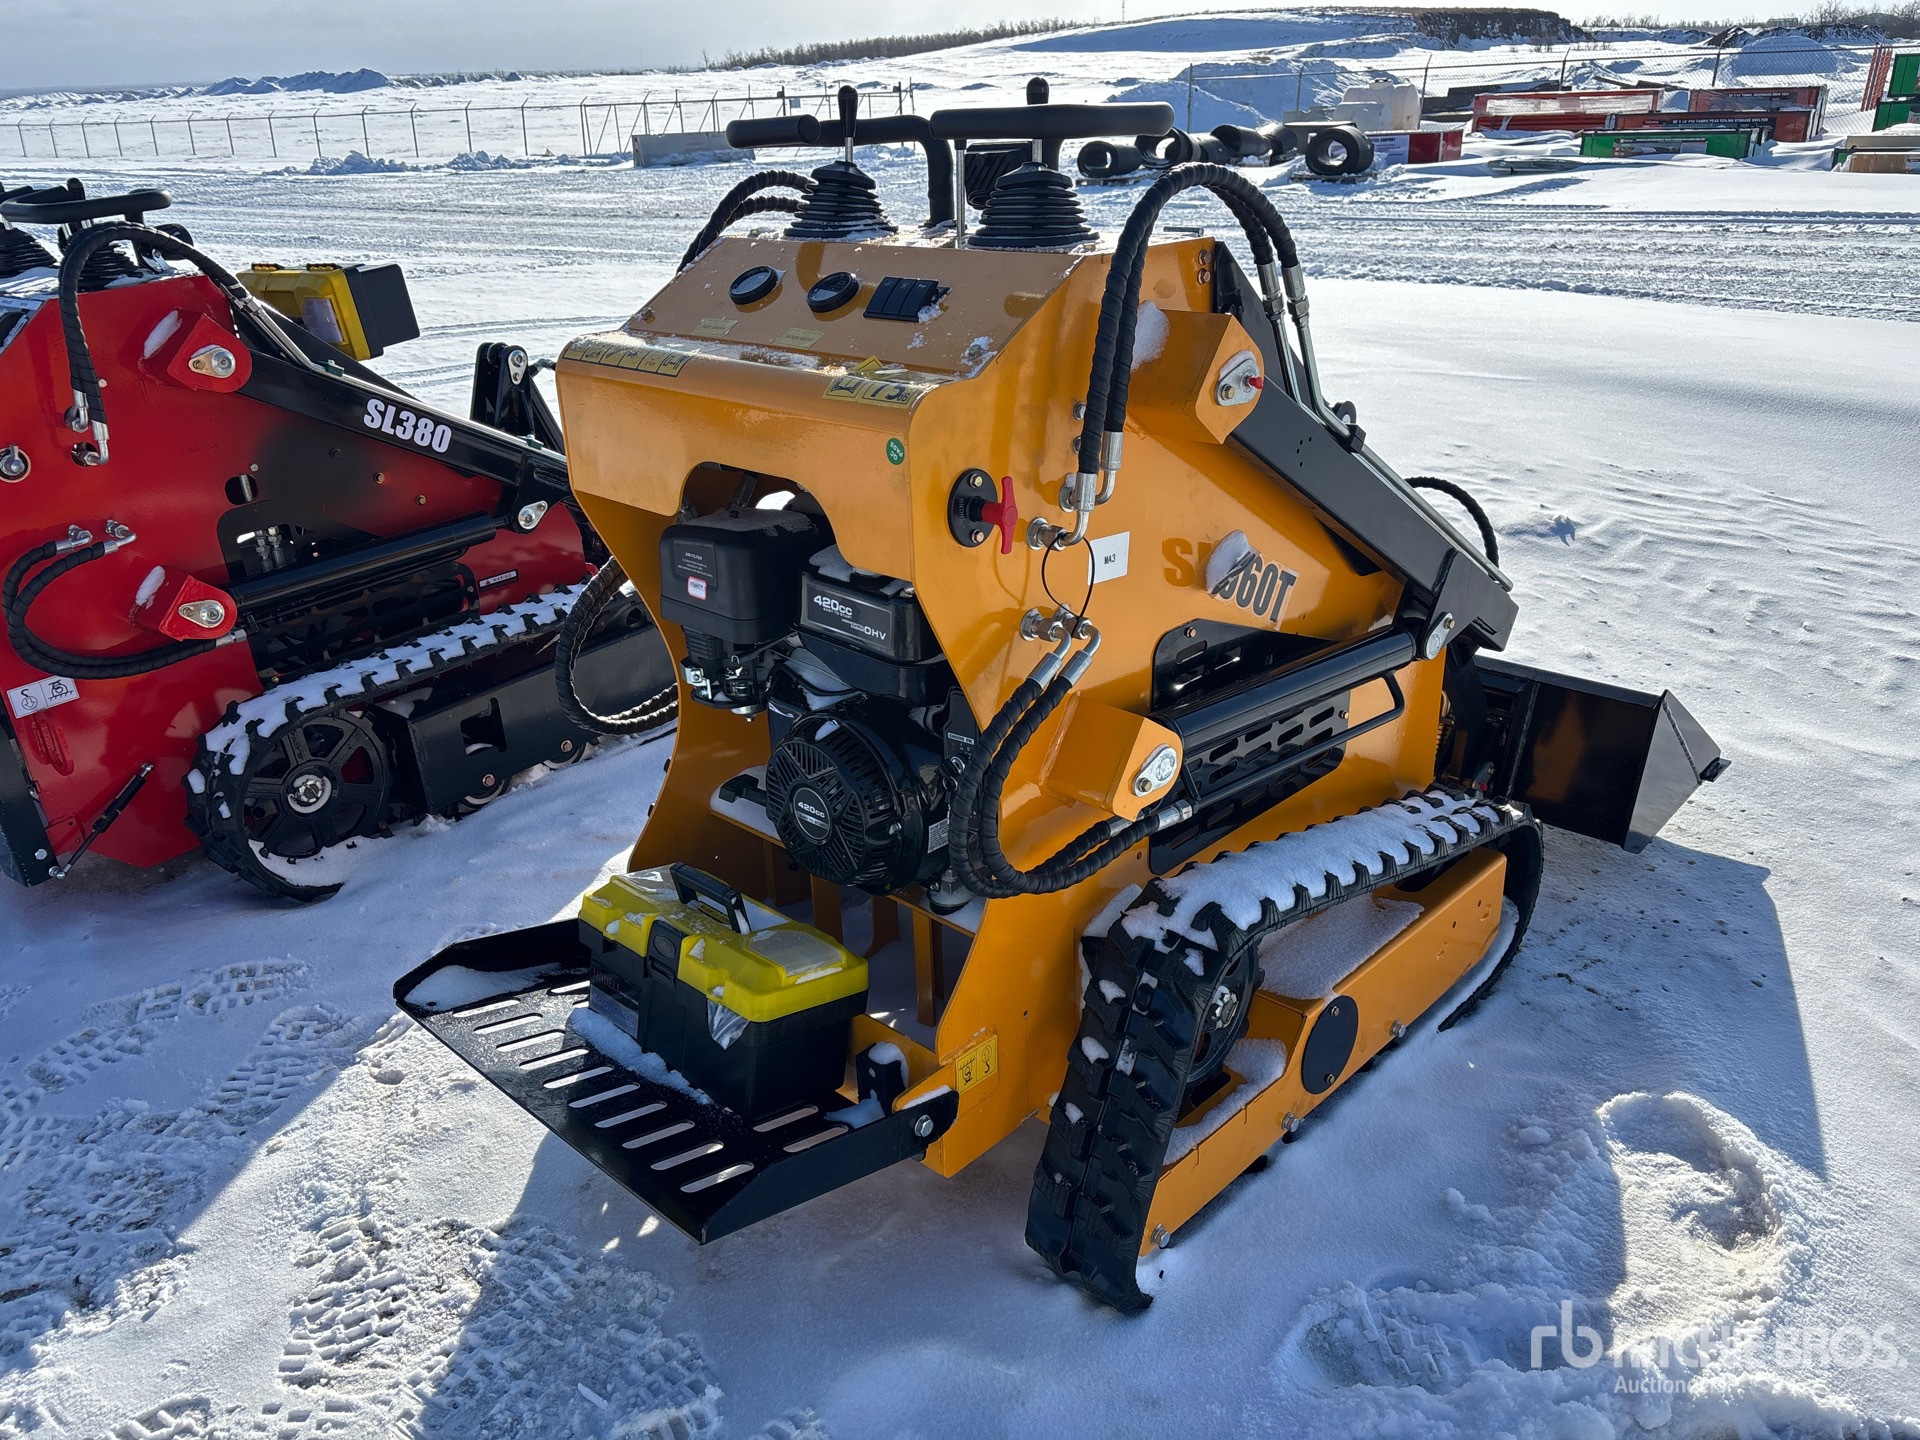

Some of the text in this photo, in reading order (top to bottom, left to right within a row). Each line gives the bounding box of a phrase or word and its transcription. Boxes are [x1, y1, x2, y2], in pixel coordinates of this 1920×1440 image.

[363, 399, 452, 453] SL380
[889, 441, 904, 458] PASS
[1104, 554, 1116, 565] MA3
[813, 595, 853, 616] 420cc
[864, 626, 887, 640] OHV
[797, 801, 825, 819] 420cc
[592, 967, 620, 993] SHIDELI
